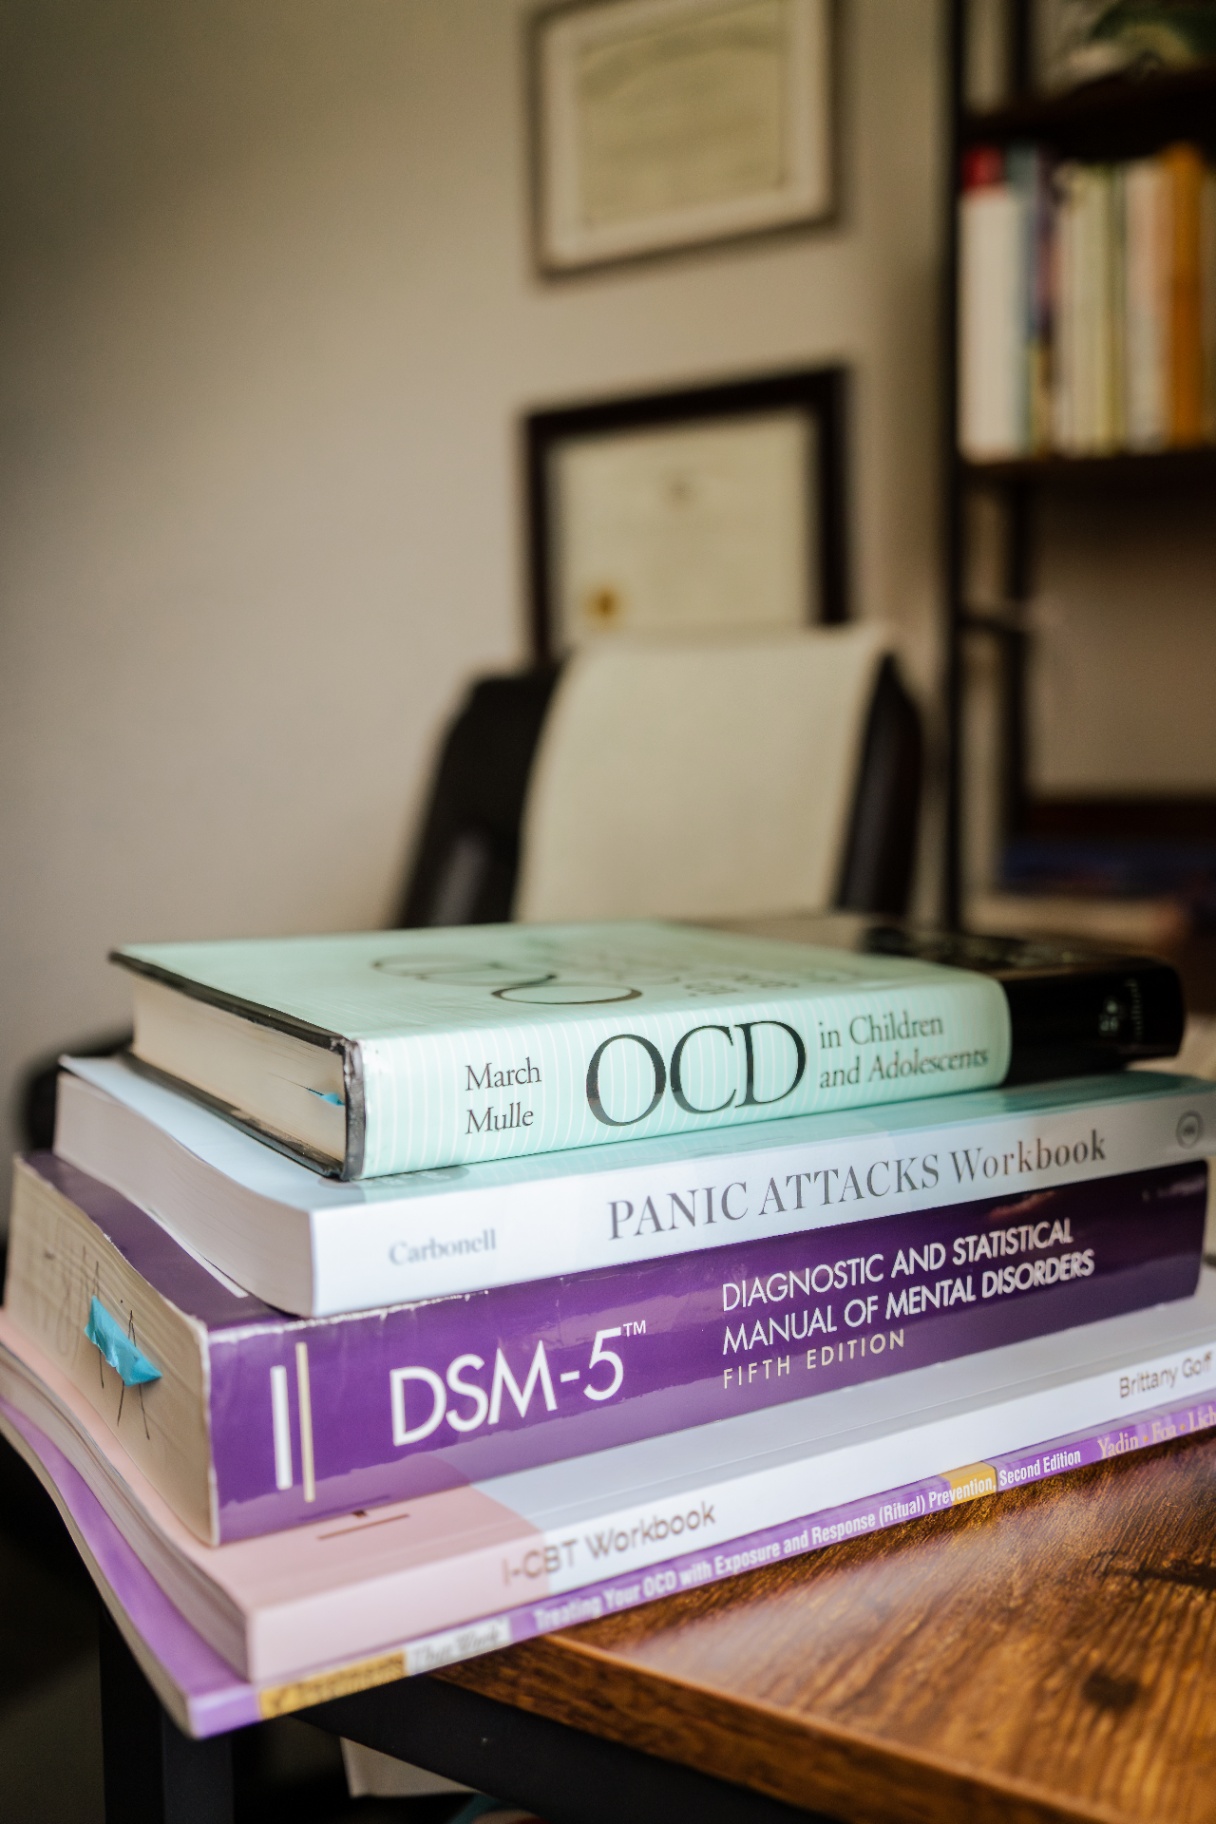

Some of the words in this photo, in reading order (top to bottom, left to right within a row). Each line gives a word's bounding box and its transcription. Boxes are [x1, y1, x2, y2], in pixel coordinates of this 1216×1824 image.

[819, 1021, 841, 1049] in
[850, 1012, 944, 1046] Children
[465, 1056, 542, 1091] March
[586, 1019, 806, 1127] OCD
[820, 1060, 860, 1089] and
[869, 1046, 989, 1082] Adolescents
[465, 1102, 534, 1134] Mulle
[607, 1181, 749, 1240] PANIC
[758, 1153, 940, 1216] ATTACKS
[949, 1129, 1107, 1184] Workbook
[388, 1228, 496, 1266] Carbonell
[722, 1253, 884, 1312] DIAGNOSTIC
[890, 1242, 946, 1280] AND
[952, 1217, 1073, 1264] STATISTICAL
[722, 1306, 837, 1355] MANUAL
[844, 1298, 878, 1328] OF
[885, 1275, 976, 1318] MENTAL
[982, 1249, 1095, 1295] DISORDERS
[723, 1354, 790, 1389] FIFTH
[807, 1329, 905, 1370] EDITION
[1119, 1364, 1178, 1399] Brittany
[1097, 1431, 1139, 1460] Yadin
[534, 1593, 601, 1633] Treating
[603, 1581, 640, 1613] Your
[643, 1570, 677, 1600] OCD
[679, 1559, 713, 1587] with
[715, 1542, 781, 1576] Exposure
[784, 1531, 808, 1554] and
[812, 1513, 875, 1546] Response
[879, 1494, 925, 1527] (Ritual)
[929, 1475, 997, 1508] Prevention,
[1000, 1461, 1041, 1487] Second
[1044, 1450, 1081, 1476] Edition
[584, 1499, 717, 1559] Workbook
